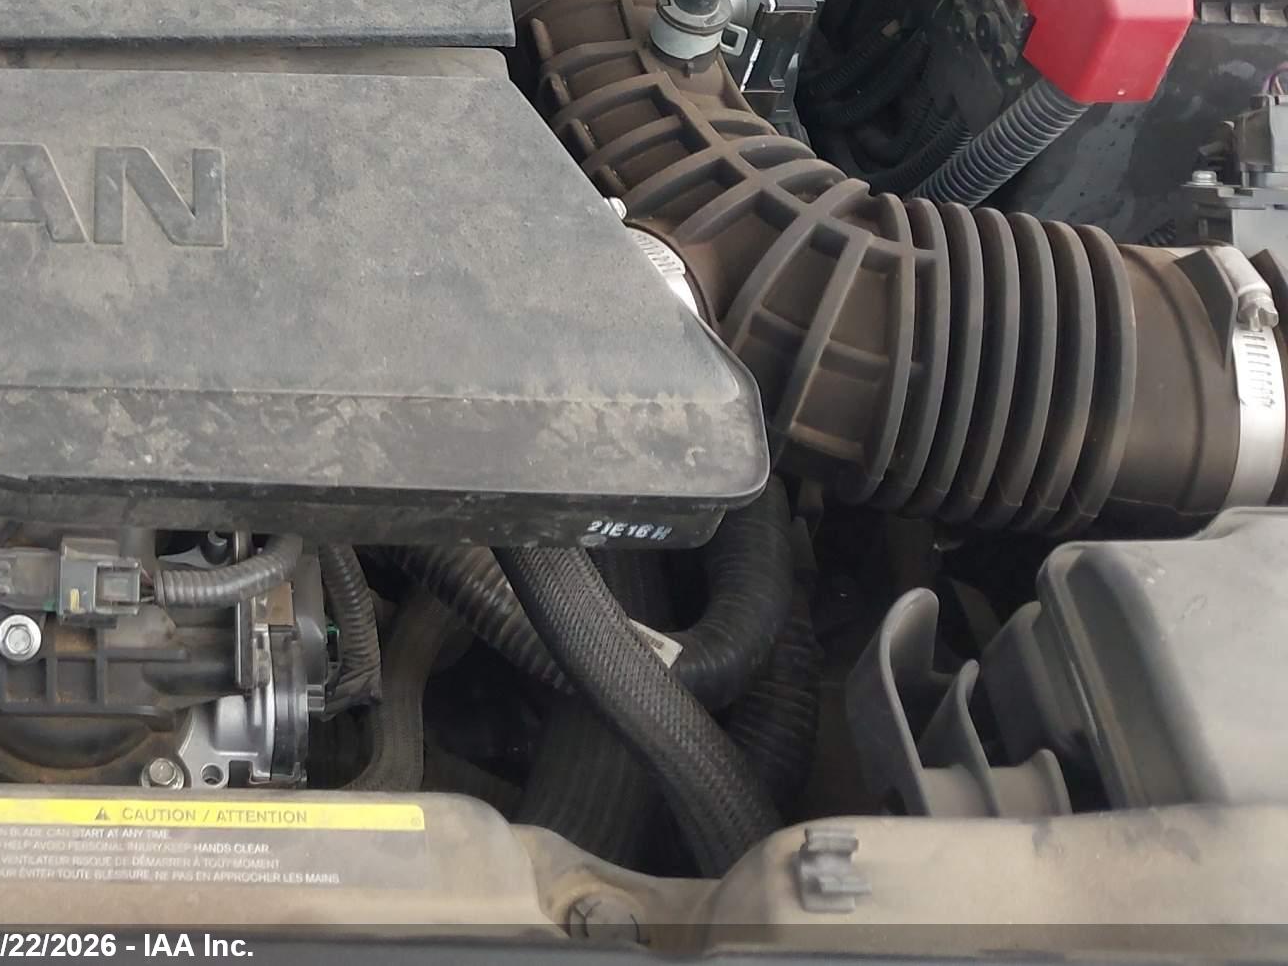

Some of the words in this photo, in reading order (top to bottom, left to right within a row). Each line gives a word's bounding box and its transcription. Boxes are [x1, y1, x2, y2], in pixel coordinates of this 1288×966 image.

[122, 808, 196, 822] CAUTION
[216, 809, 307, 824] ATTENTION
[73, 828, 105, 838] START
[107, 828, 120, 838] AT
[122, 828, 143, 838] ANY
[4, 840, 31, 851] HELP
[33, 840, 65, 851] AVOID
[68, 841, 125, 852] PERSONAL
[194, 842, 231, 853] HANDS
[1, 855, 70, 865] VENTILATEUR
[73, 856, 112, 867] RISQUE
[115, 857, 130, 867] DE
[132, 854, 191, 867] DÉMARRER
[18, 866, 55, 879] ÉVITER
[57, 869, 89, 879] TOUTE
[155, 871, 169, 881] NE
[172, 871, 193, 881] PAS
[196, 872, 210, 882] EN
[213, 872, 280, 882] APPROCHER
[283, 873, 303, 883] LES
